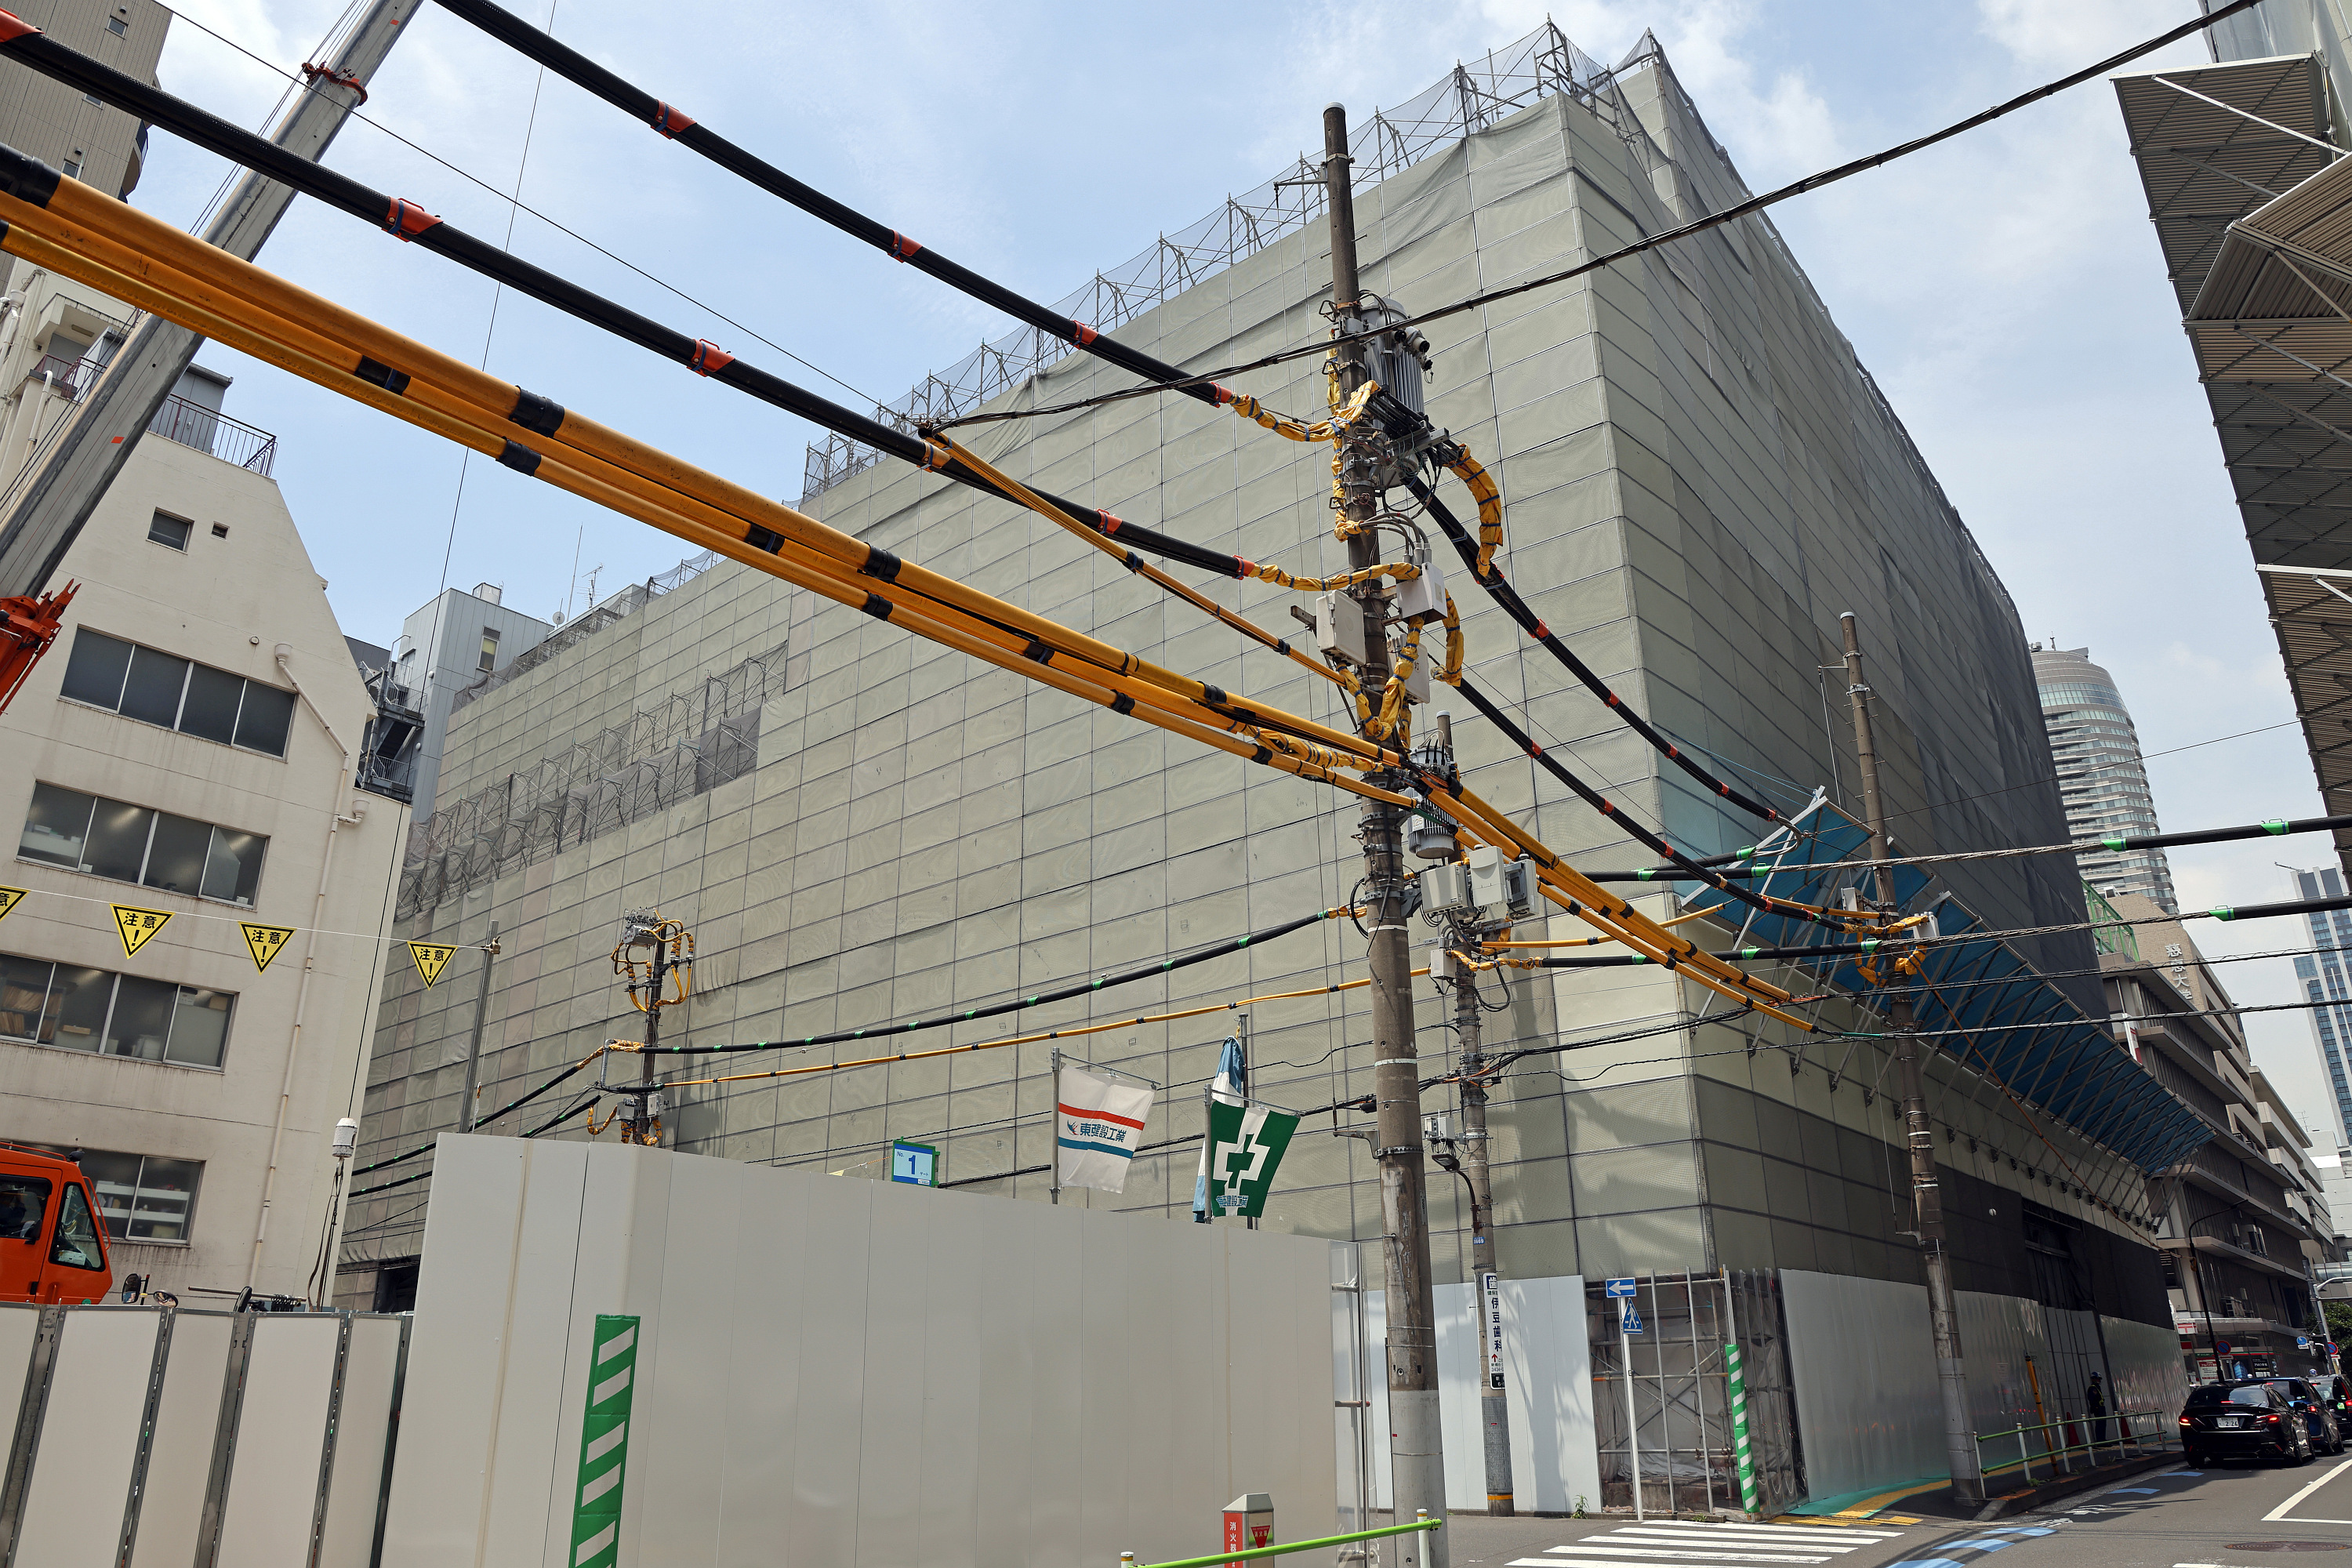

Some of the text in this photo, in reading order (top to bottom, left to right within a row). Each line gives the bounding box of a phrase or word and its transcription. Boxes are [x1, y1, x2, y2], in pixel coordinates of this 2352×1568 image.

[123, 913, 157, 929] 注意
[251, 929, 281, 944] 注意
[419, 948, 445, 961] 注意
[908, 1155, 916, 1174] 1
